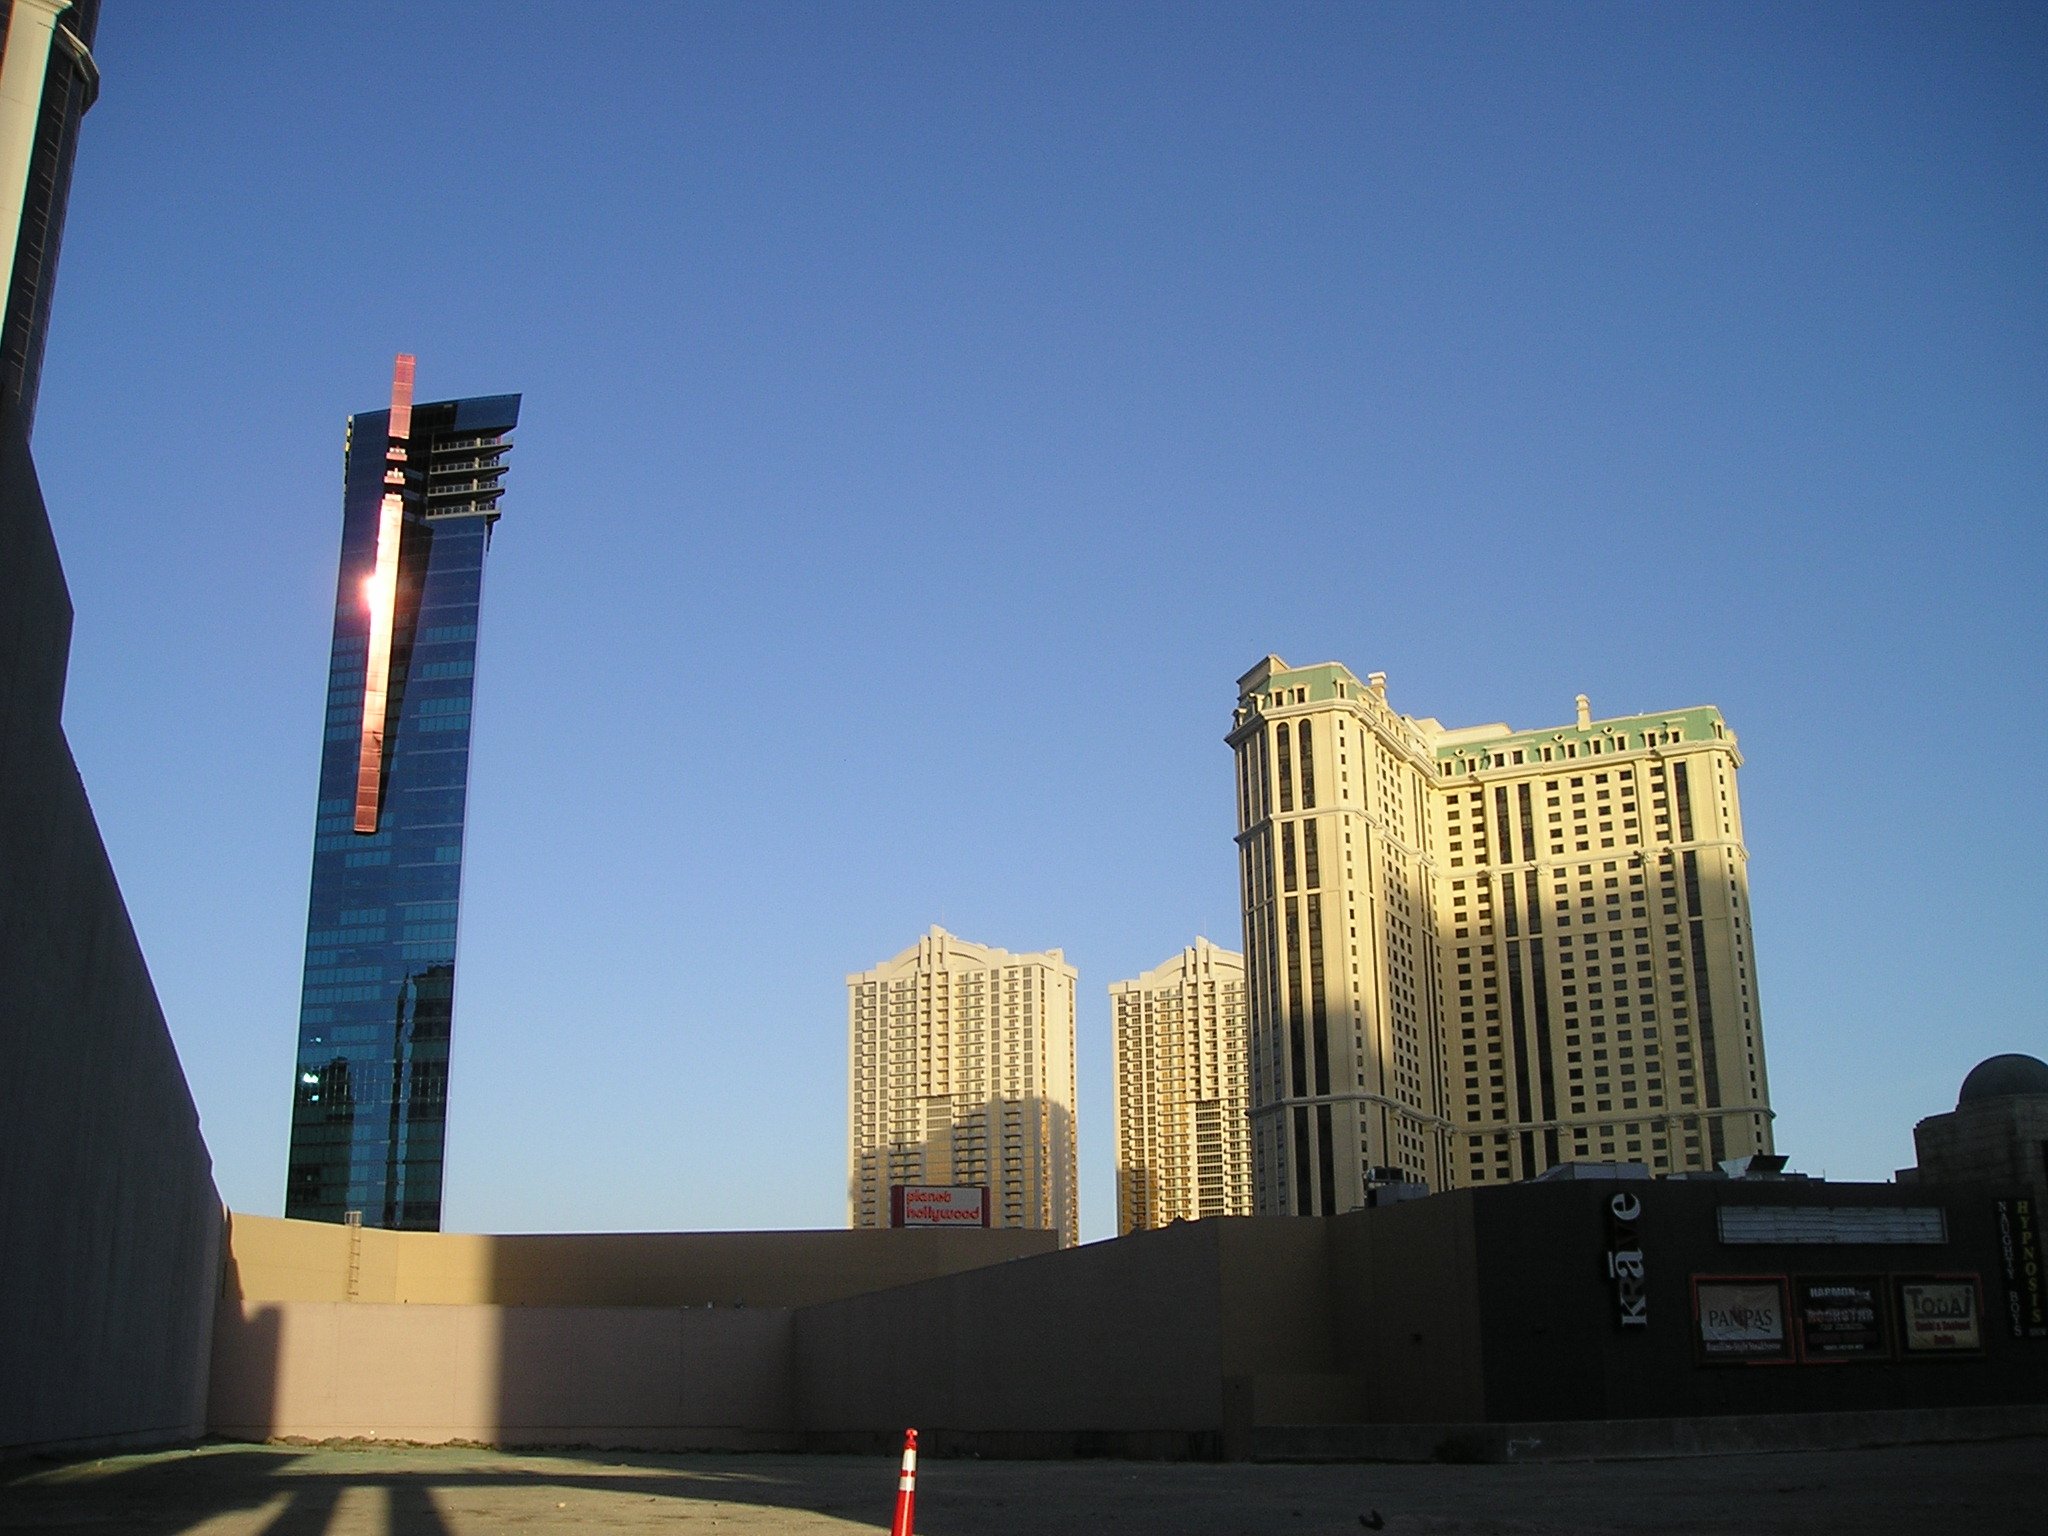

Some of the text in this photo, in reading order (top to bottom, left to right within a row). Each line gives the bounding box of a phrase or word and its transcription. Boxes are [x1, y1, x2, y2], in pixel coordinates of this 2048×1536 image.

[906, 1190, 952, 1205] planet
[906, 1205, 980, 1222] hollywood
[2016, 1200, 2042, 1324] HYPNOSIS
